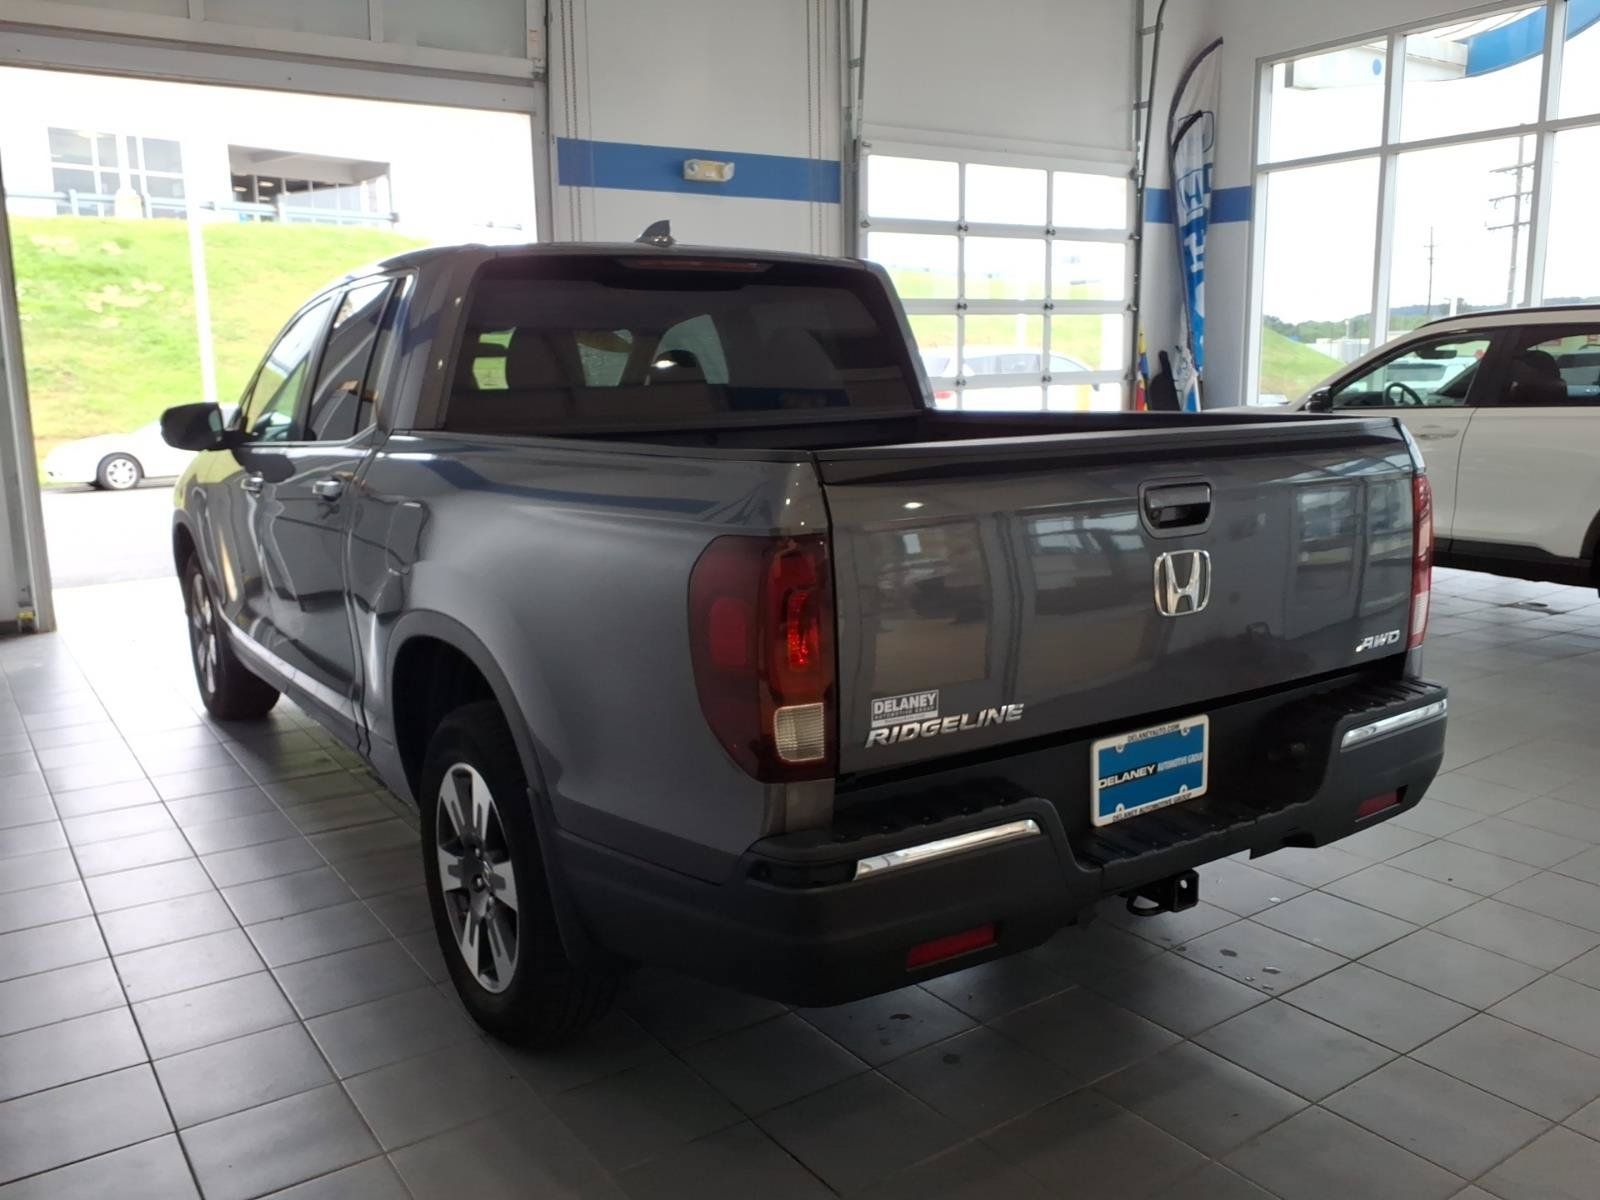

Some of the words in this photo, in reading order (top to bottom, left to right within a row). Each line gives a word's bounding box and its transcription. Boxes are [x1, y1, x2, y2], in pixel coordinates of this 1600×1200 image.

[1355, 629, 1400, 652] AWD
[874, 693, 937, 714] DELANEY
[865, 703, 1024, 748] RIDGELINE
[1097, 764, 1156, 789] DELANEY
